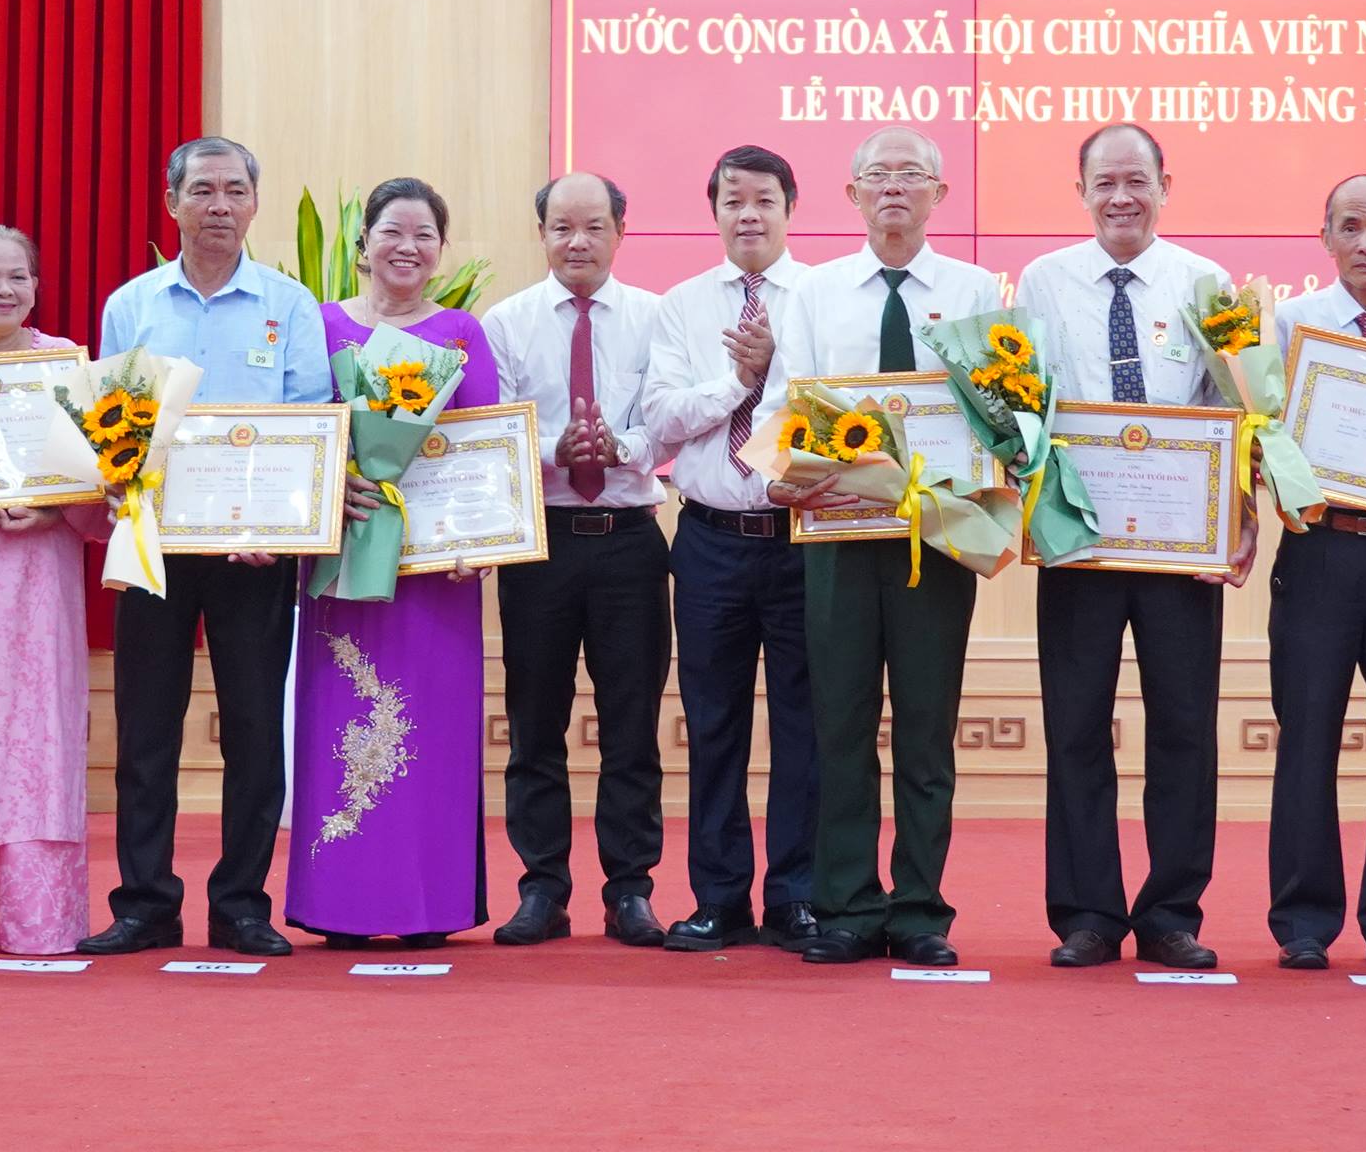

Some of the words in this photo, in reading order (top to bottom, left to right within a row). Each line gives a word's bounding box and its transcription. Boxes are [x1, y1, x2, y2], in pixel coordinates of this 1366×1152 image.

[581, 7, 690, 54] NƯỚC
[697, 12, 806, 64] CỘNG
[814, 7, 895, 55] HÒA
[901, 9, 954, 54] XÃ
[962, 12, 1035, 65] HỘI
[1043, 8, 1123, 55] CHỦ
[1131, 9, 1254, 55] NGHĨA
[1259, 13, 1348, 65] VIỆT
[778, 75, 828, 122] LỄ
[835, 84, 939, 122] TRAO
[947, 80, 1053, 132] TẶNG
[1061, 86, 1141, 122] HUY
[1148, 80, 1241, 132] HIỆU
[1249, 75, 1356, 123] ĐẢNG
